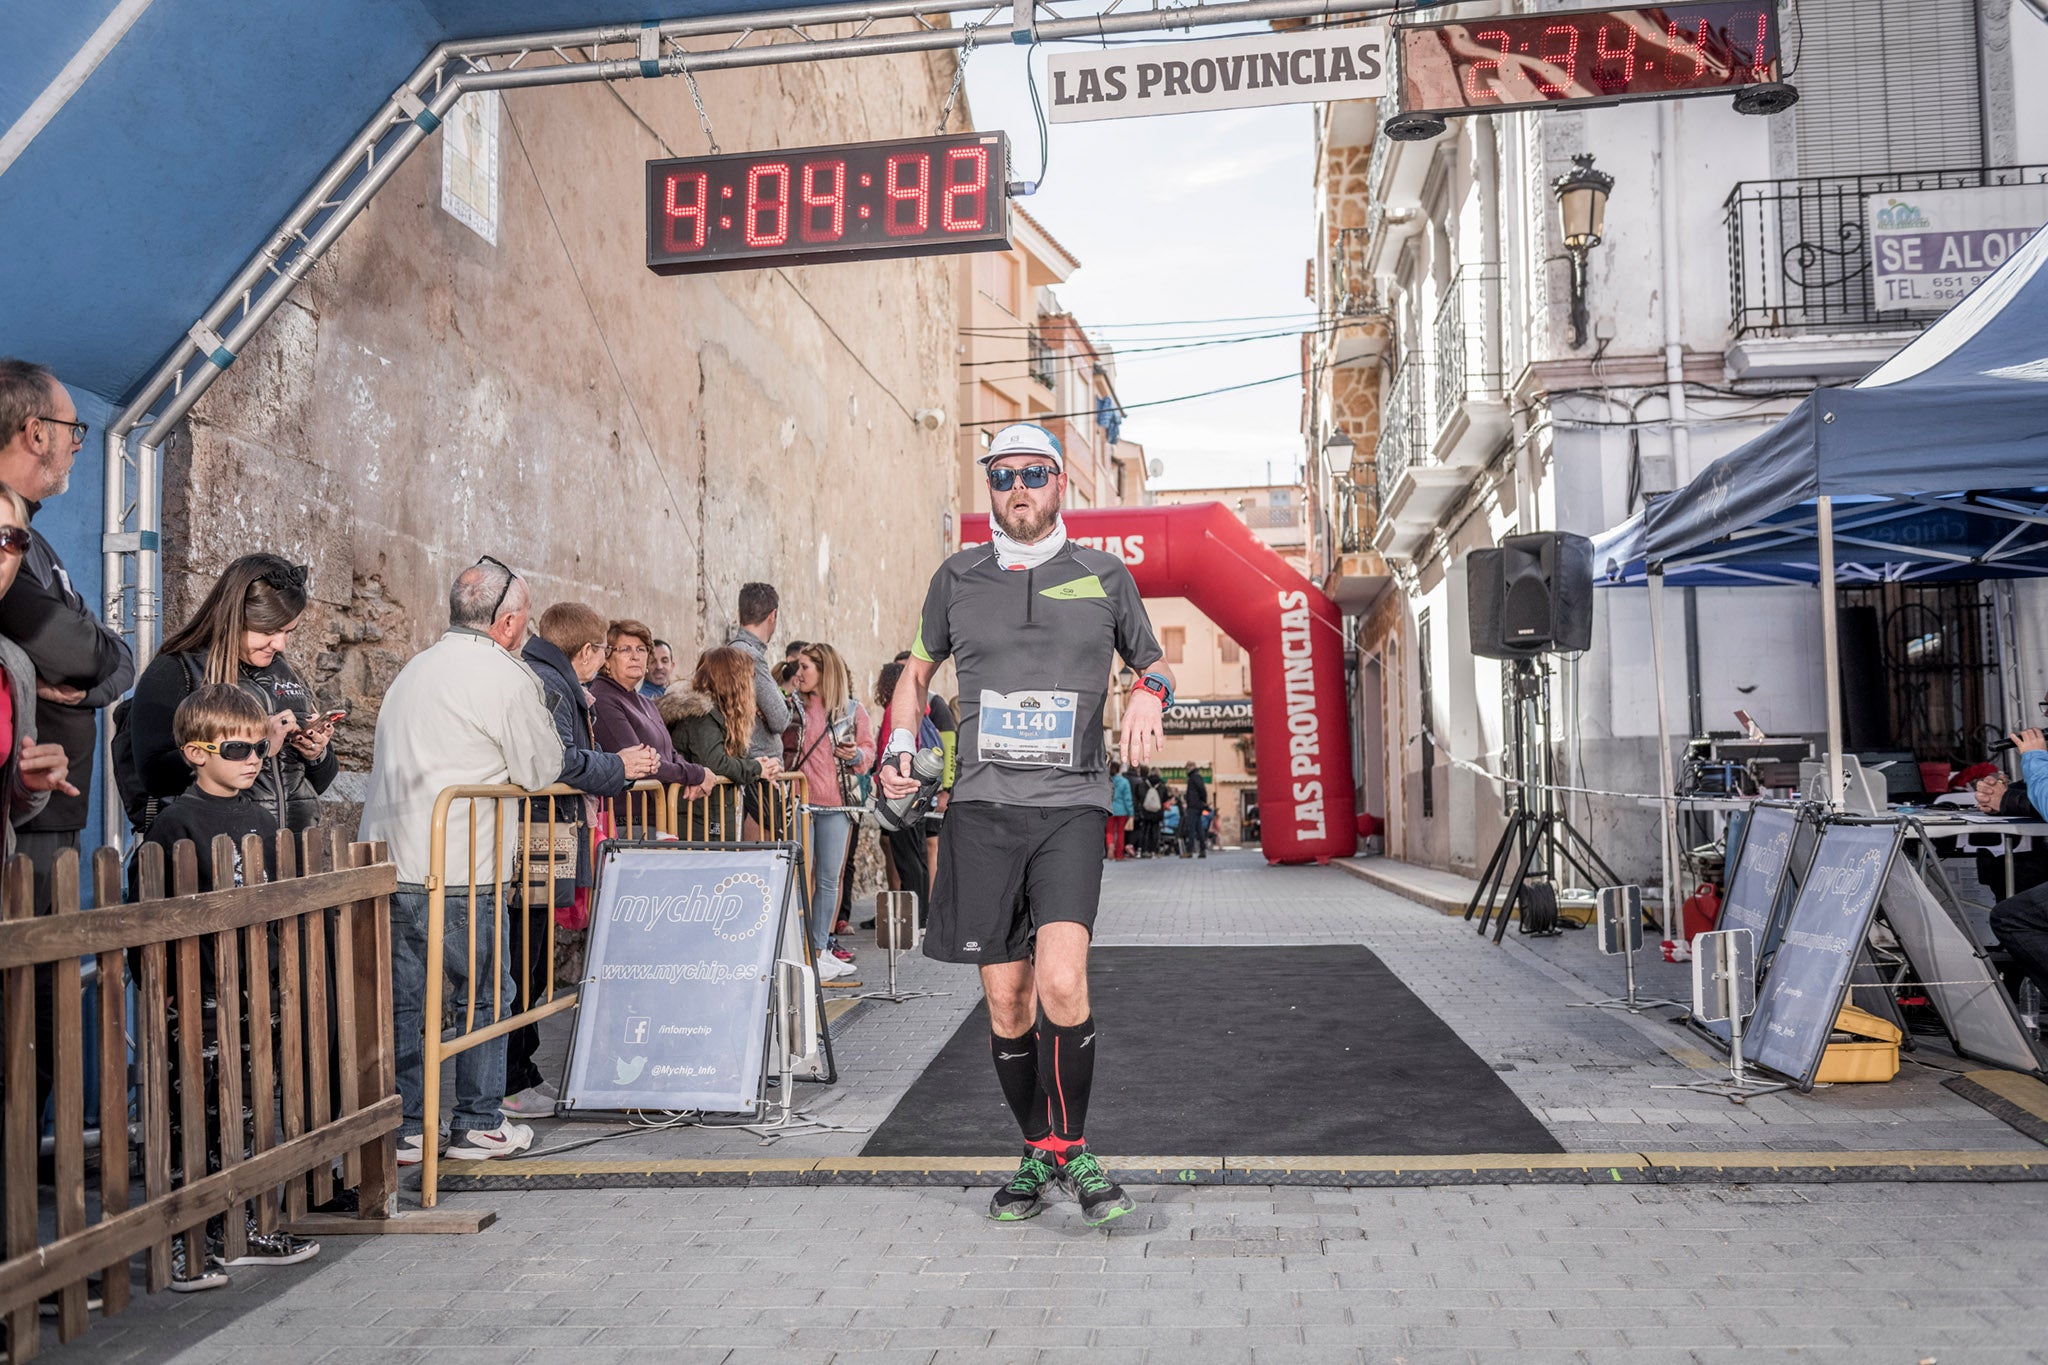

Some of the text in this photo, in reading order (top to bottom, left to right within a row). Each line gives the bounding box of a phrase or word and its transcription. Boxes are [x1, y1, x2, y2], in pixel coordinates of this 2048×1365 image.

[1054, 44, 1382, 105] LAS PROVINCIAS
[665, 147, 988, 249] 4:04:42
[1881, 231, 2037, 271] SE ALQU
[1932, 277, 1964, 288] 651
[1002, 712, 1056, 731] 1140
[1191, 720, 1211, 731] para
[1278, 590, 1327, 841] LAS PROVINCIAS
[611, 885, 743, 932] mychip
[602, 960, 758, 985] www.mychip.es
[658, 1024, 712, 1036] /infomychip
[651, 1065, 717, 1077] @Mychip_Info
